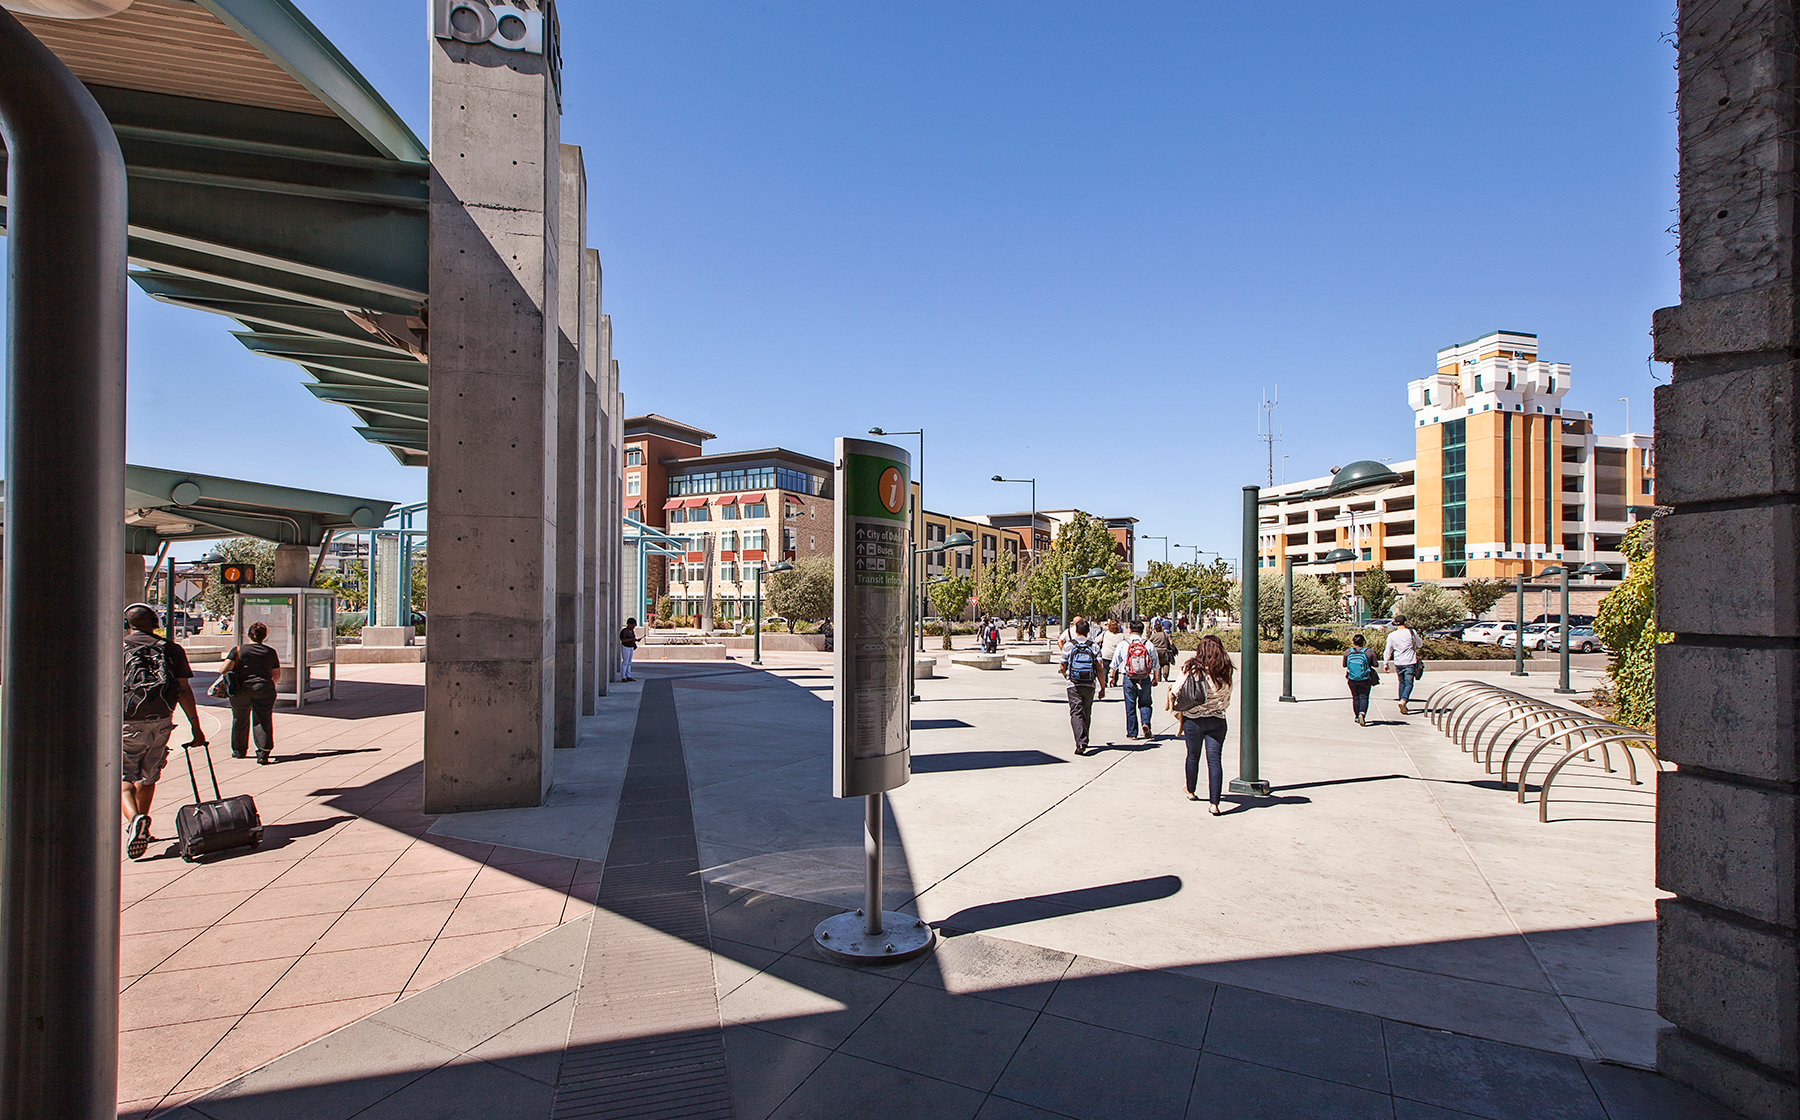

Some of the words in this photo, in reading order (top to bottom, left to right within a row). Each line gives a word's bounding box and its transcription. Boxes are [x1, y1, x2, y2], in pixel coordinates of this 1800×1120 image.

[889, 473, 898, 508] i
[866, 529, 880, 541] City
[881, 530, 889, 540] of
[877, 545, 894, 555] Buses
[856, 574, 884, 584] Transit
